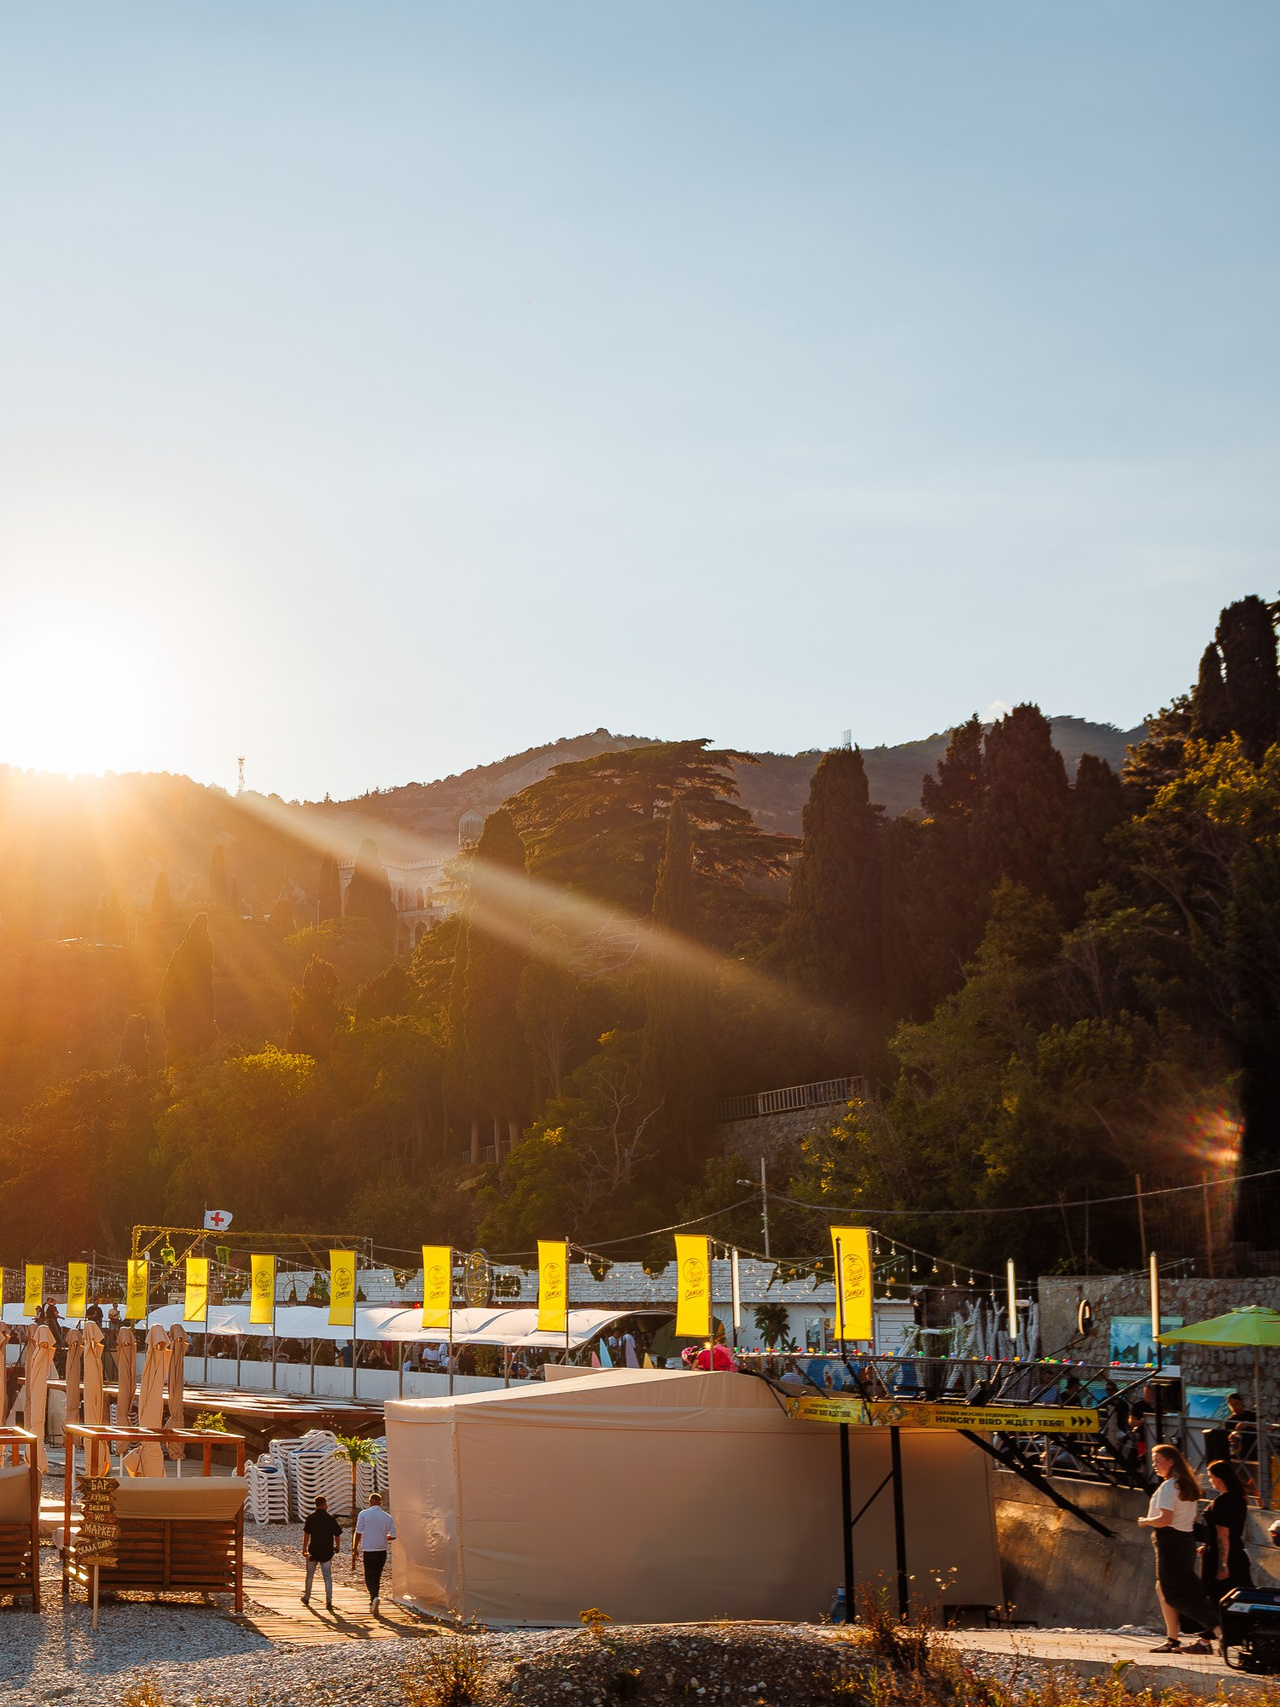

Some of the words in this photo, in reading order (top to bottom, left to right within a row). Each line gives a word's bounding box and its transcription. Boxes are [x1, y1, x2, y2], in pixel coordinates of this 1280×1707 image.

[935, 1415, 976, 1425] HUNGRY
[978, 1417, 1002, 1426] BIRD
[1004, 1417, 1035, 1427] ЖДЁТ
[1036, 1419, 1065, 1427] ТЕБЯ!
[91, 1479, 109, 1491] БАР
[94, 1513, 105, 1522] WC
[84, 1523, 117, 1538] МАРКЕТ
[77, 1543, 98, 1555] СКАЛА
